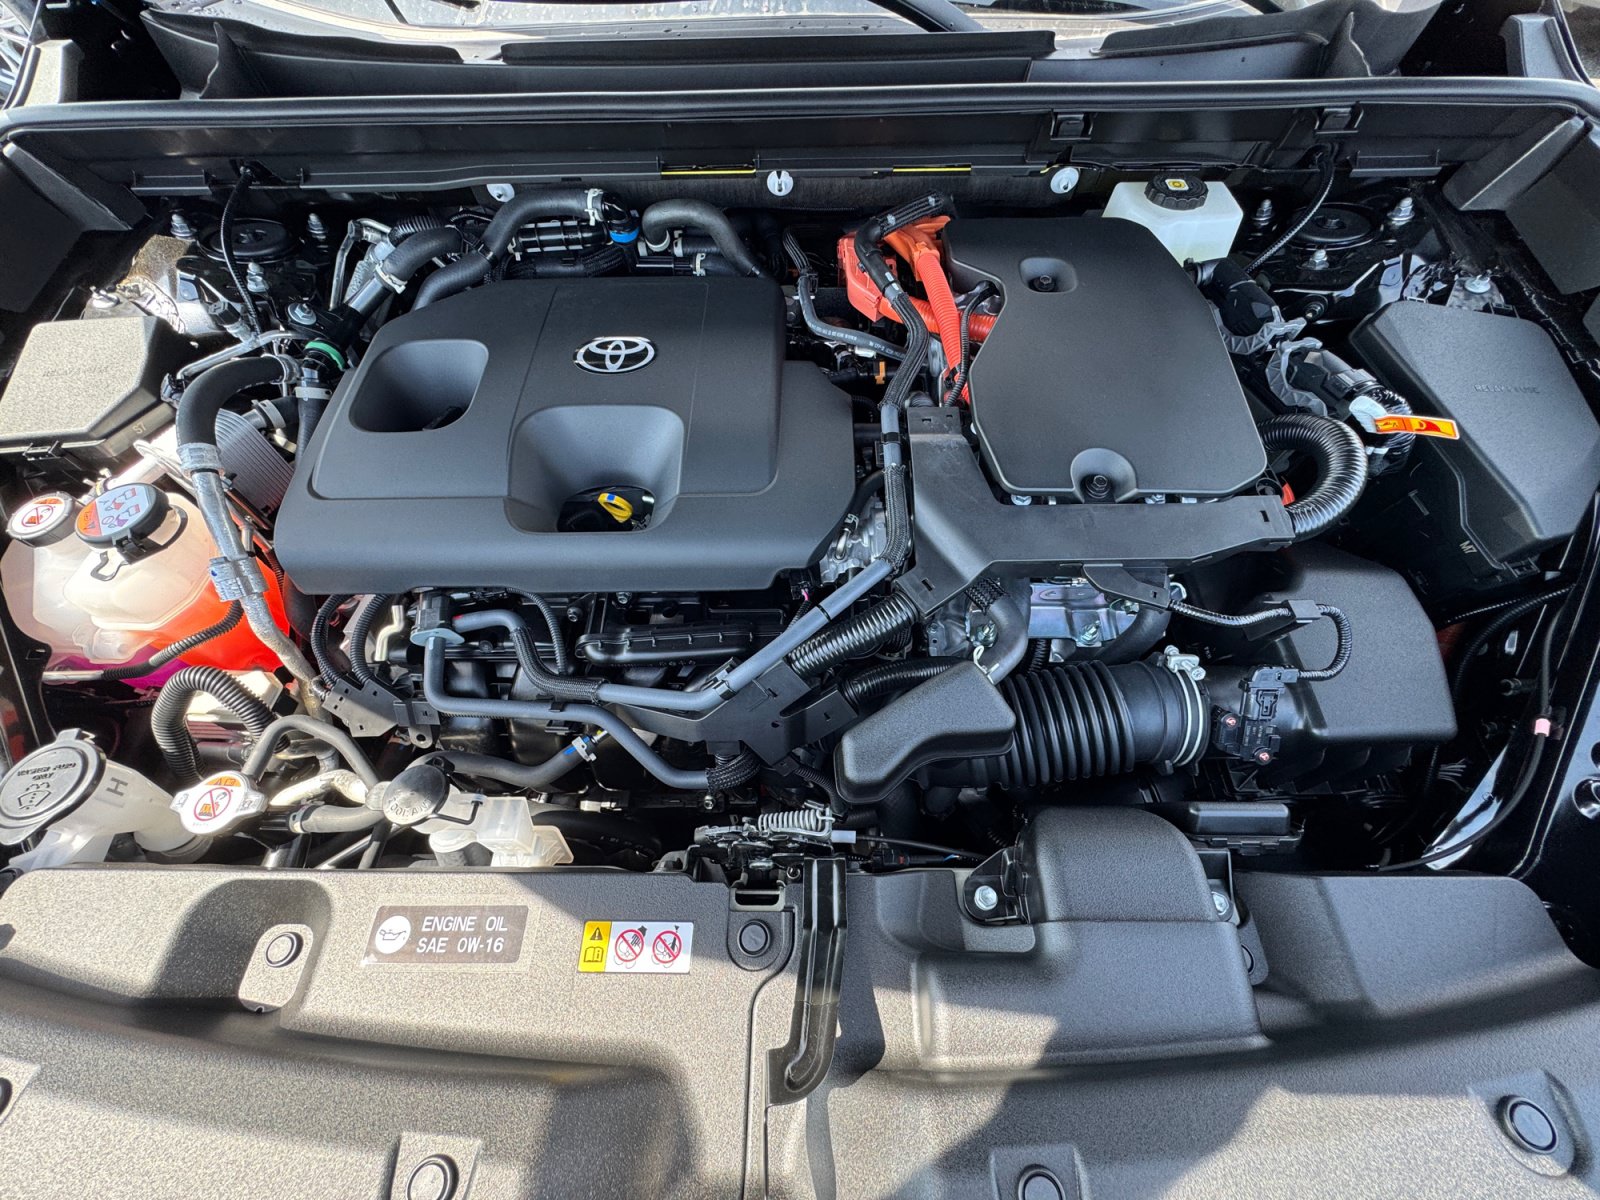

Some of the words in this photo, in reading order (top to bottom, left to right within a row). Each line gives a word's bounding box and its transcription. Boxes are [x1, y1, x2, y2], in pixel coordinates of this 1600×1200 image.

[1459, 540, 1478, 554] M7
[421, 915, 478, 932] ENGINE
[485, 915, 508, 932] OIL
[416, 936, 449, 953] SAE
